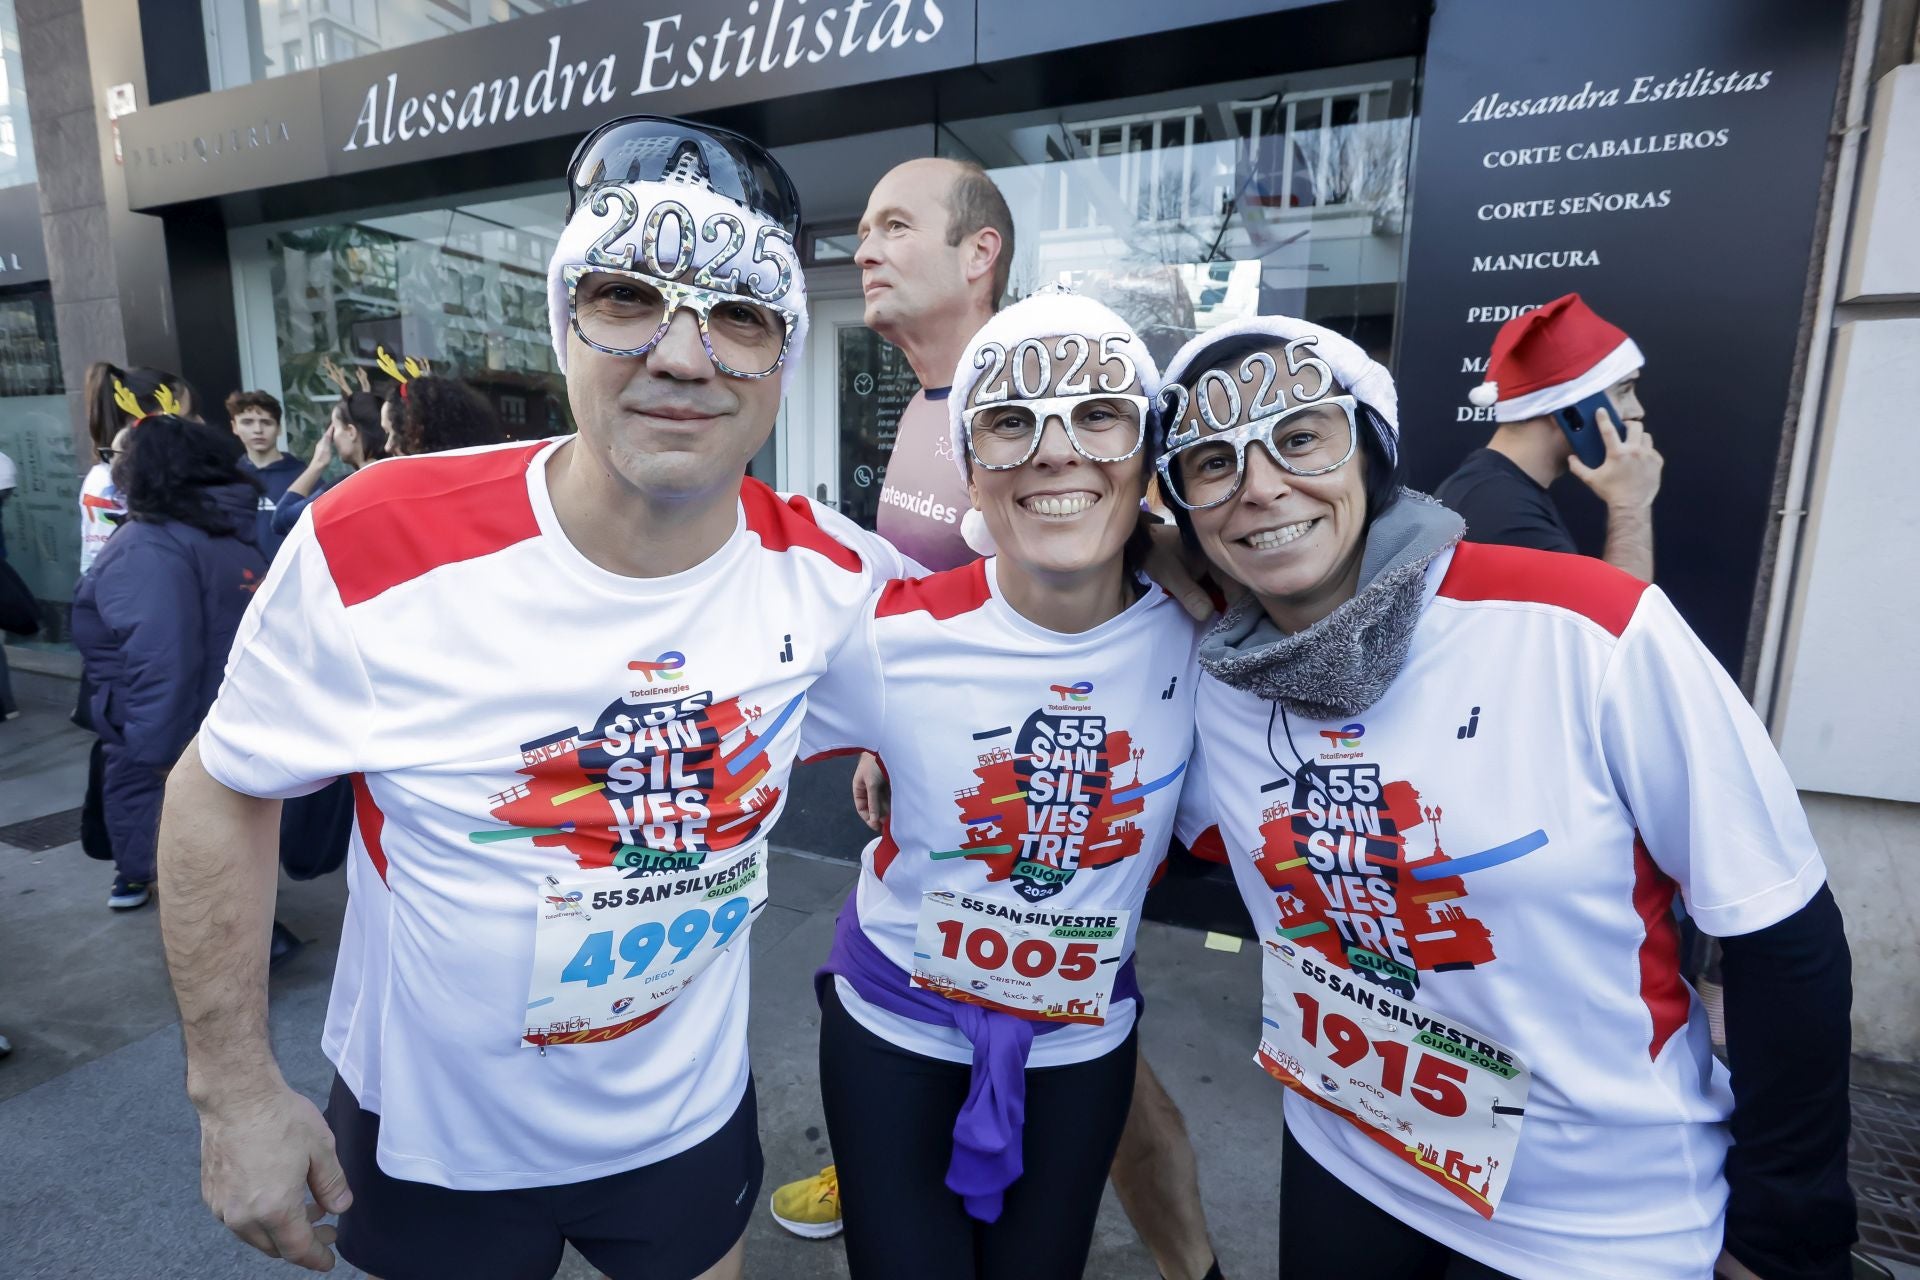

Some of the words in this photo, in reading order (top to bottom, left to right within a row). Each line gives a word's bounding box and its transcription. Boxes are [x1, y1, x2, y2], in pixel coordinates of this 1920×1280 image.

[342, 35, 617, 152] Alessandra
[631, 0, 945, 97] Estilistas
[1457, 81, 1620, 123] Alessandra
[1624, 67, 1773, 106] Estilistas
[1482, 145, 1562, 168] CORTE
[1565, 128, 1729, 160] CABALLEROS
[1477, 199, 1555, 221] CORTE
[1559, 189, 1671, 215] SEÑORAS
[585, 186, 794, 302] 2025
[1471, 249, 1601, 272] MANICURA
[973, 332, 1136, 405] 2025
[1156, 335, 1333, 446] 2025
[630, 684, 690, 698] TotalEnergies
[1048, 704, 1091, 712] TotalEnergies
[601, 714, 702, 757] SAN
[1056, 719, 1103, 747] 55
[606, 753, 699, 794] SIL
[1030, 736, 1097, 773] SAN
[1319, 752, 1364, 761] TotalEnergies
[1028, 770, 1090, 803] SIL
[1328, 767, 1379, 802] 55
[608, 789, 711, 828] VES
[1027, 804, 1090, 833] VES
[1306, 790, 1382, 837] SAN
[1018, 834, 1084, 871] TRE
[1307, 830, 1382, 876] SIL
[592, 890, 623, 910] 55
[625, 882, 672, 906] SAN
[673, 851, 757, 896] SILVESTRE
[1020, 863, 1066, 882] GIJÓN
[1024, 885, 1054, 897] 2024
[961, 897, 984, 912] 55
[985, 903, 1022, 924] SAN
[1024, 912, 1117, 929] SILVESTRE
[1313, 874, 1398, 916] VES
[560, 896, 750, 988] 4999
[936, 919, 1098, 981] 1005
[1055, 928, 1086, 938] GIJÓN
[1088, 929, 1113, 938] 2024
[1323, 909, 1416, 972] TRE
[645, 969, 675, 984] DIEGO
[990, 975, 1032, 987] CRISTINA
[1301, 958, 1326, 984] 55
[1328, 974, 1374, 1010] SAN
[1376, 998, 1515, 1068] SILVESTRE
[1292, 992, 1469, 1118] 1915
[1420, 1033, 1467, 1058] GIJÓN
[1469, 1053, 1510, 1077] 2024
[1349, 1078, 1384, 1099] ROCIO
